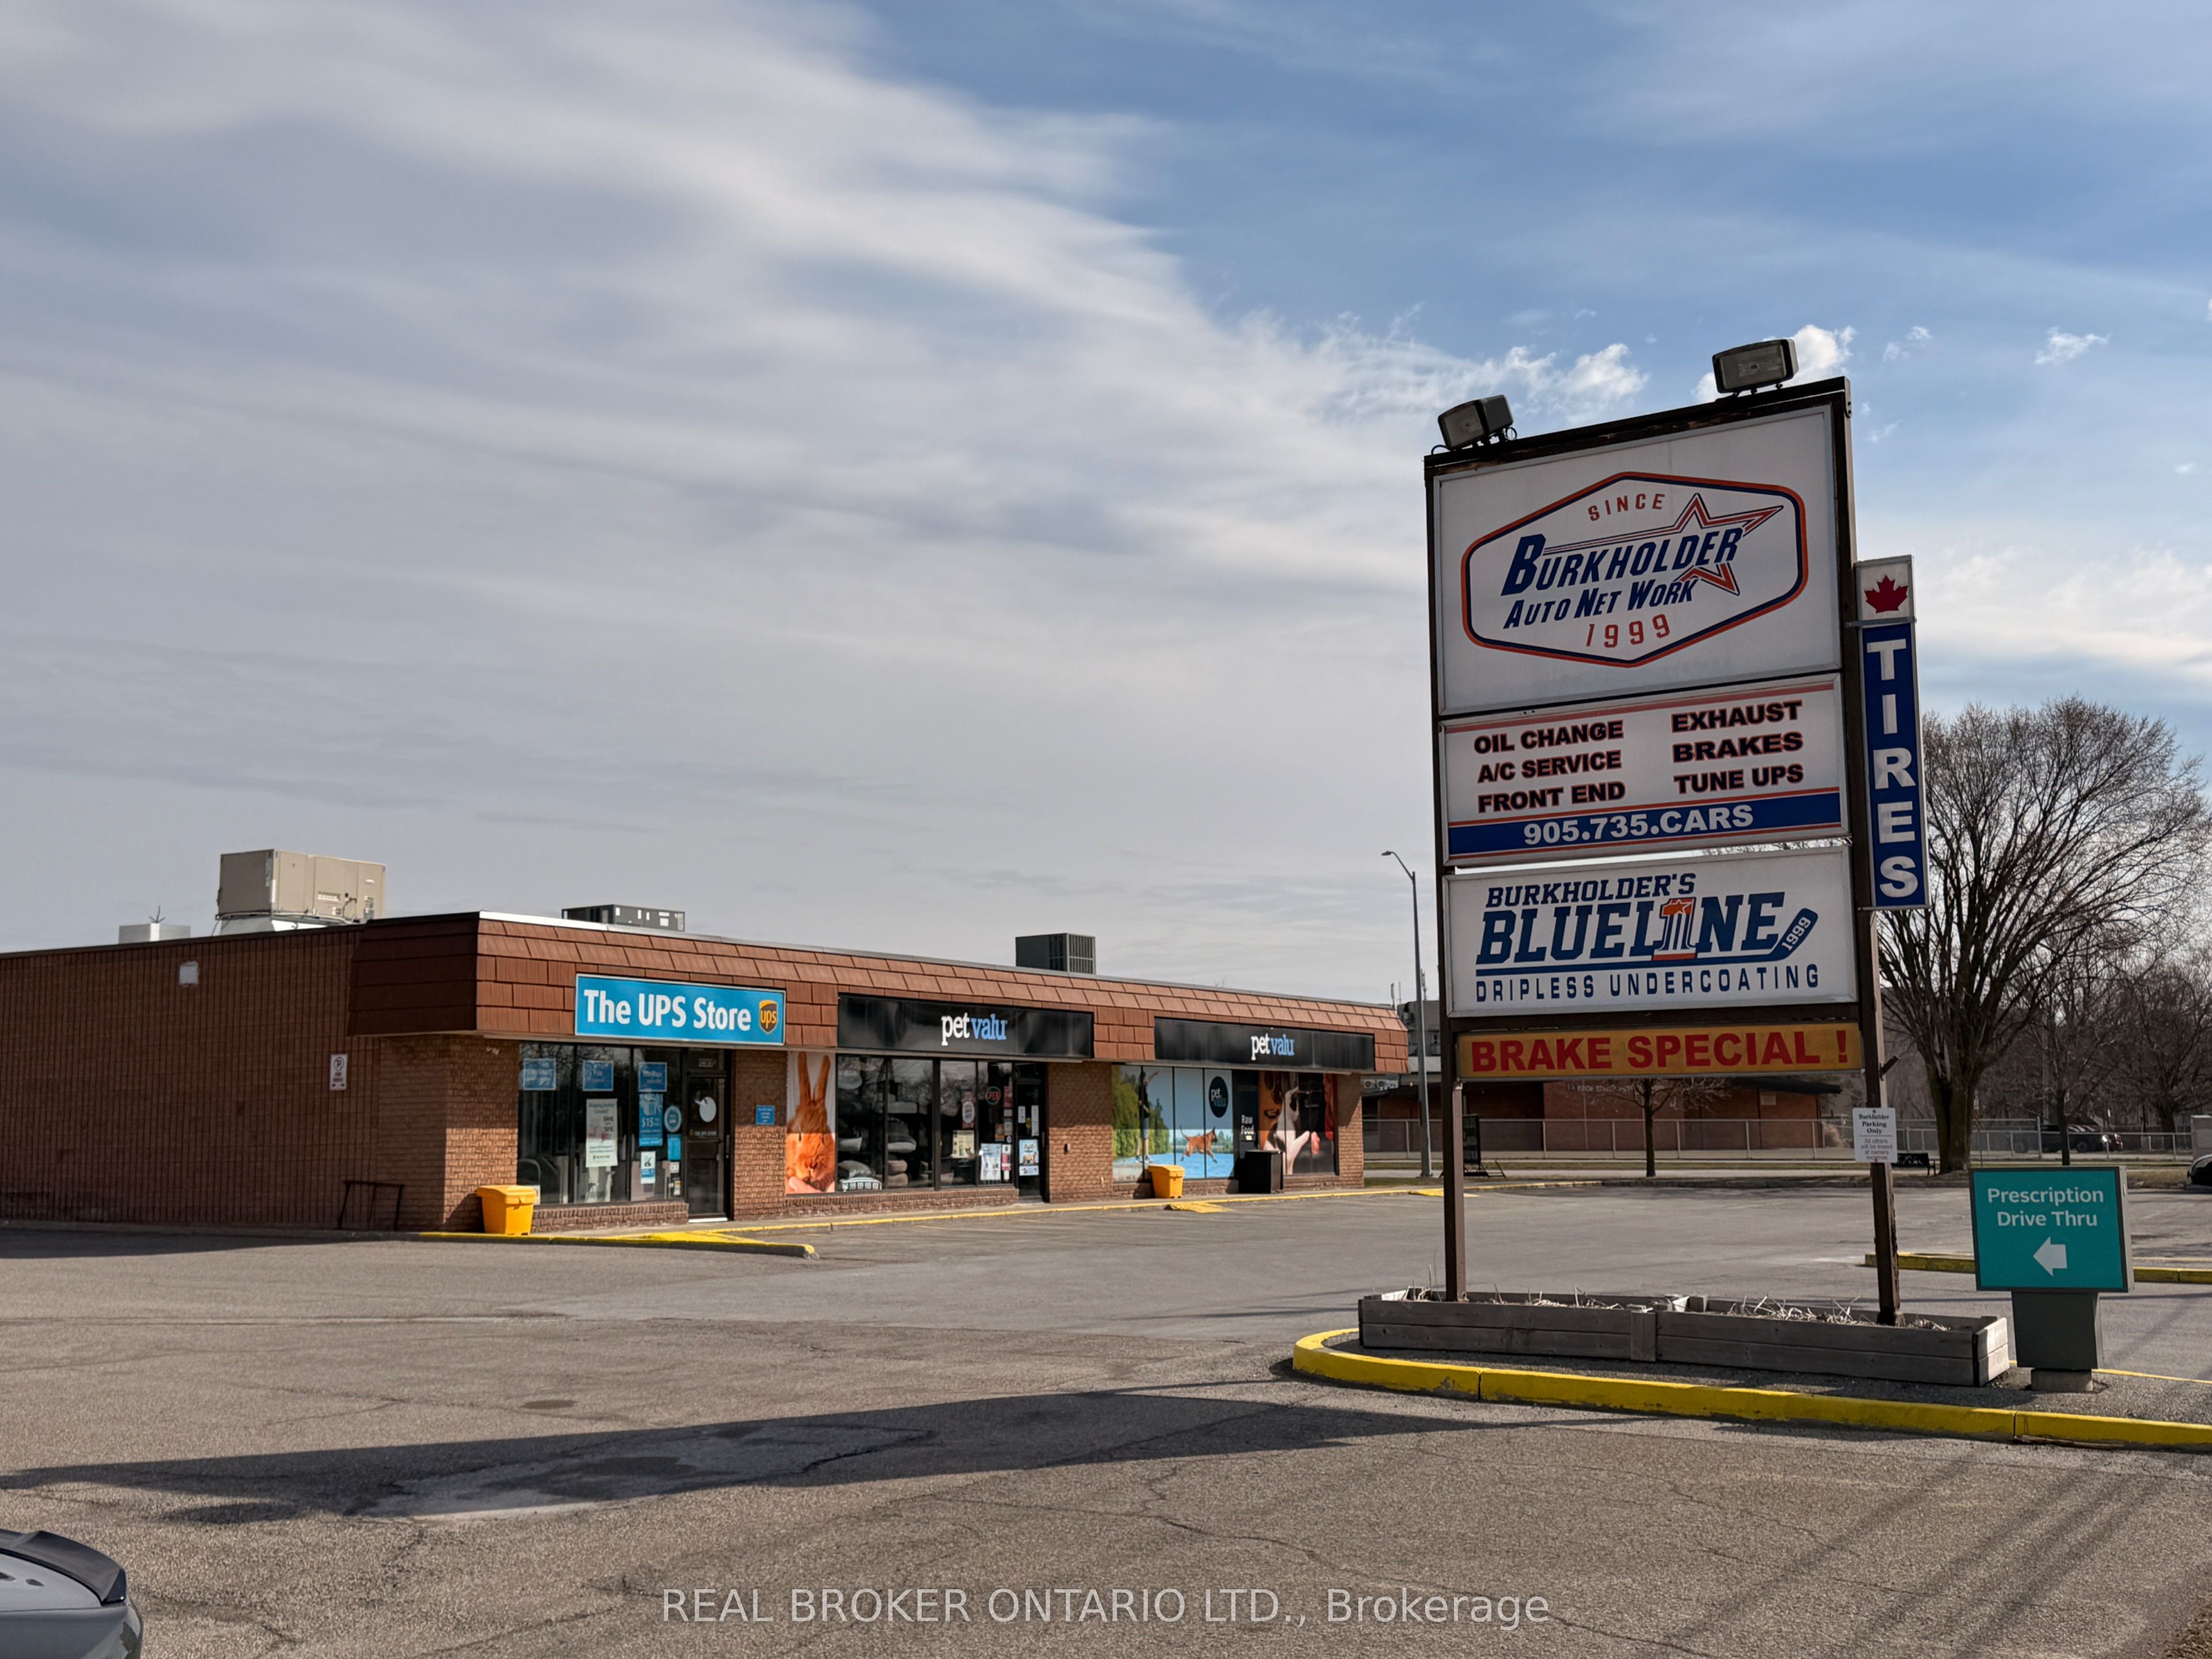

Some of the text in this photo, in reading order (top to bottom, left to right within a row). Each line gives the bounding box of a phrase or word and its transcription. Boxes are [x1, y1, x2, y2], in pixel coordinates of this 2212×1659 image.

[1588, 493, 1665, 521] SINCE
[1501, 527, 1743, 596] BURKHOLDER
[1503, 579, 1697, 629] AUTO NET WORK
[1586, 613, 1671, 648] 1999
[1672, 699, 1802, 733] EXHAUST
[1474, 720, 1624, 754] OIL CHANGE
[1673, 732, 1804, 763] BRAKES
[1477, 750, 1622, 784] A/C SERVICE
[1674, 764, 1804, 794] TUNE UPS
[1866, 638, 1919, 899] TIRES
[1478, 781, 1626, 813] FRONT END
[1524, 804, 1753, 846] 905.735.CARS
[1487, 873, 1697, 908] BURKHOLDER'S
[1782, 916, 1811, 951] 1999
[1476, 963, 1819, 1002] DRIPLESS UNDERCOATING
[584, 990, 752, 1031] The UPS Store
[760, 1009, 777, 1029] ups
[941, 1012, 1007, 1046] pet valu
[1251, 1032, 1295, 1060] pet valu
[1472, 1036, 1613, 1073] BRAKE
[1627, 1031, 1820, 1069] SPECIAL
[1241, 1114, 1253, 1124] Raw
[1241, 1125, 1255, 1135] Food
[1987, 1187, 2104, 1206] Prescription
[1997, 1210, 2097, 1226] Drive Thru
